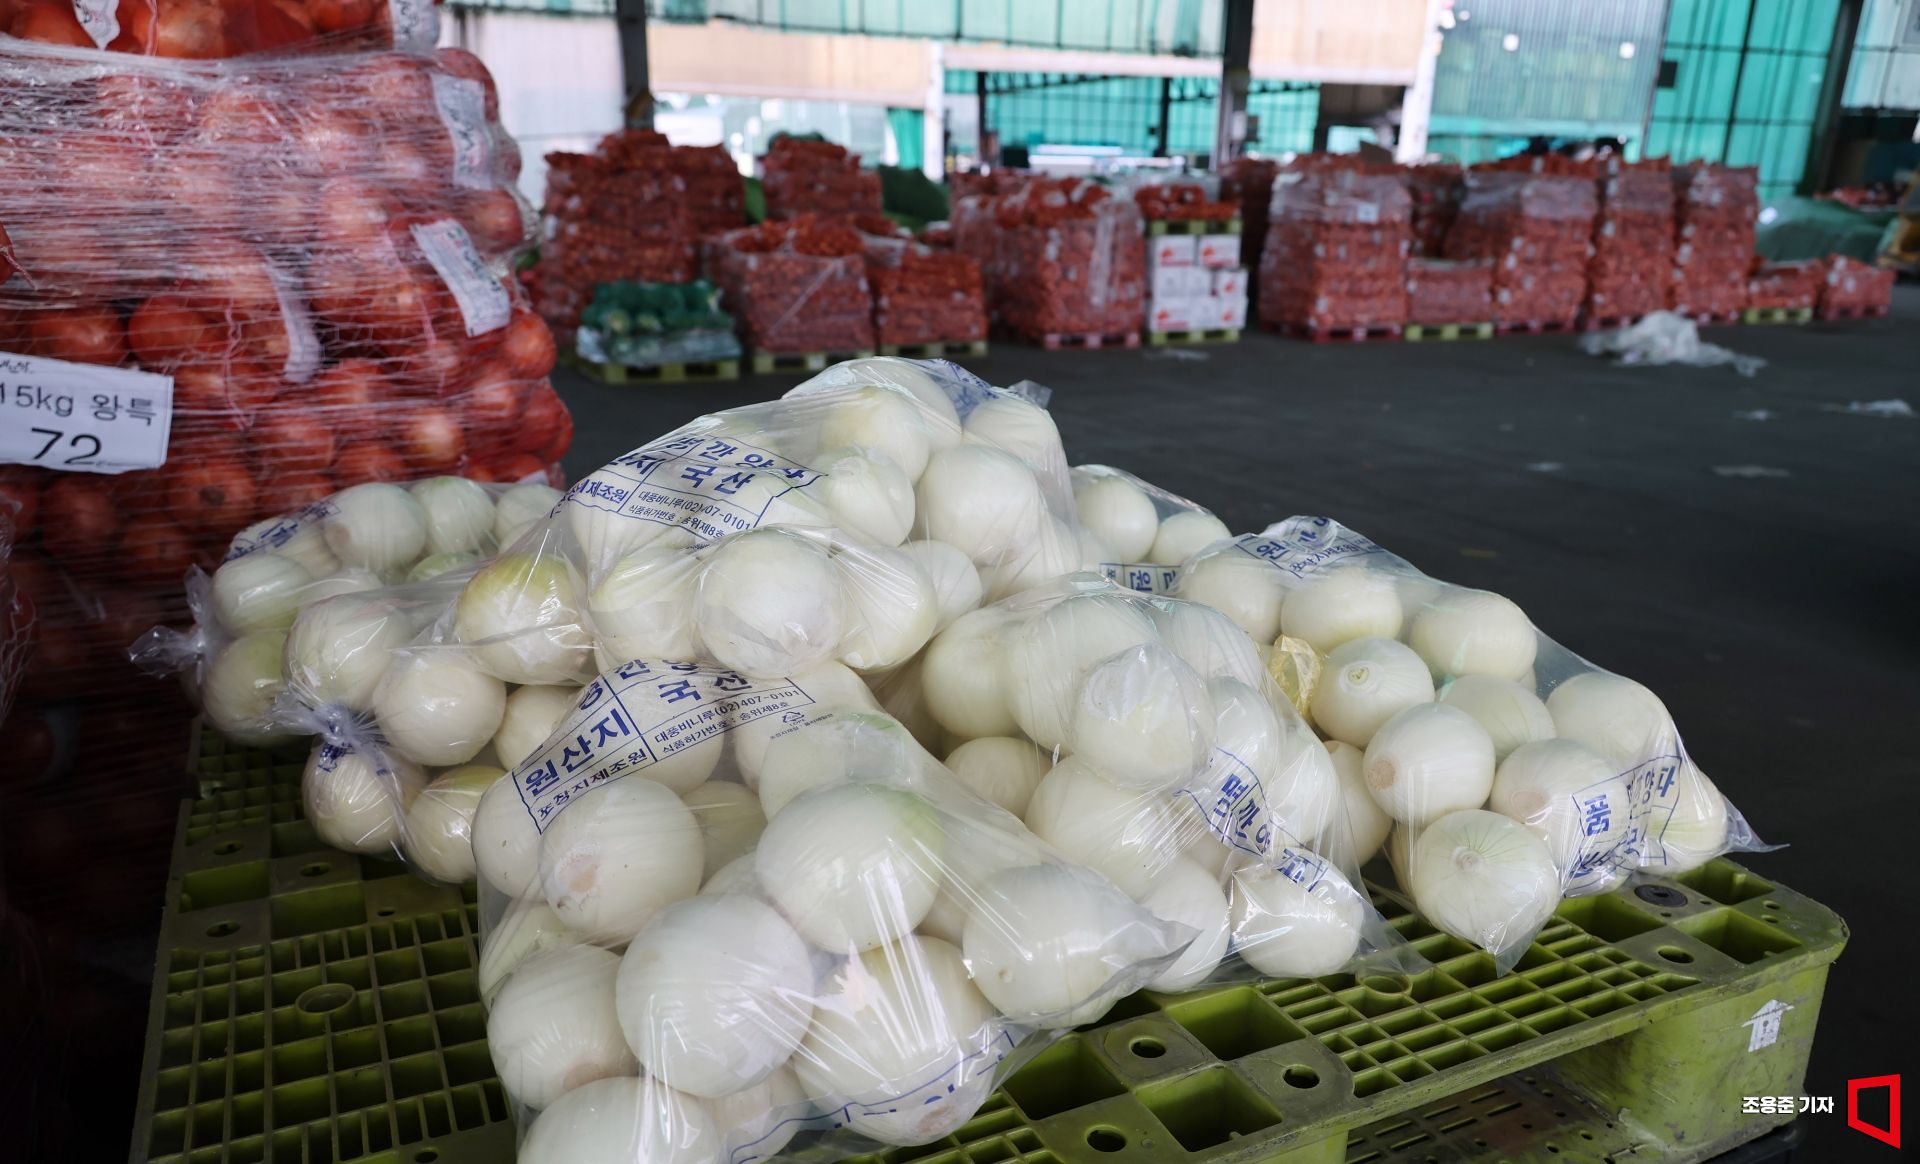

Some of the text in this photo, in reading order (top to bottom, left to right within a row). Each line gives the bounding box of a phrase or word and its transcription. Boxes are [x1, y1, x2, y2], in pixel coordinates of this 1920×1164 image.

[0, 382, 157, 426] 15kg 왕특
[31, 427, 102, 465] 72
[654, 689, 801, 744] 대풍비니루(02)407-0101
[662, 719, 730, 754] 식품허가번호
[526, 708, 631, 797] 원산지
[537, 748, 648, 822] 포장지제조원
